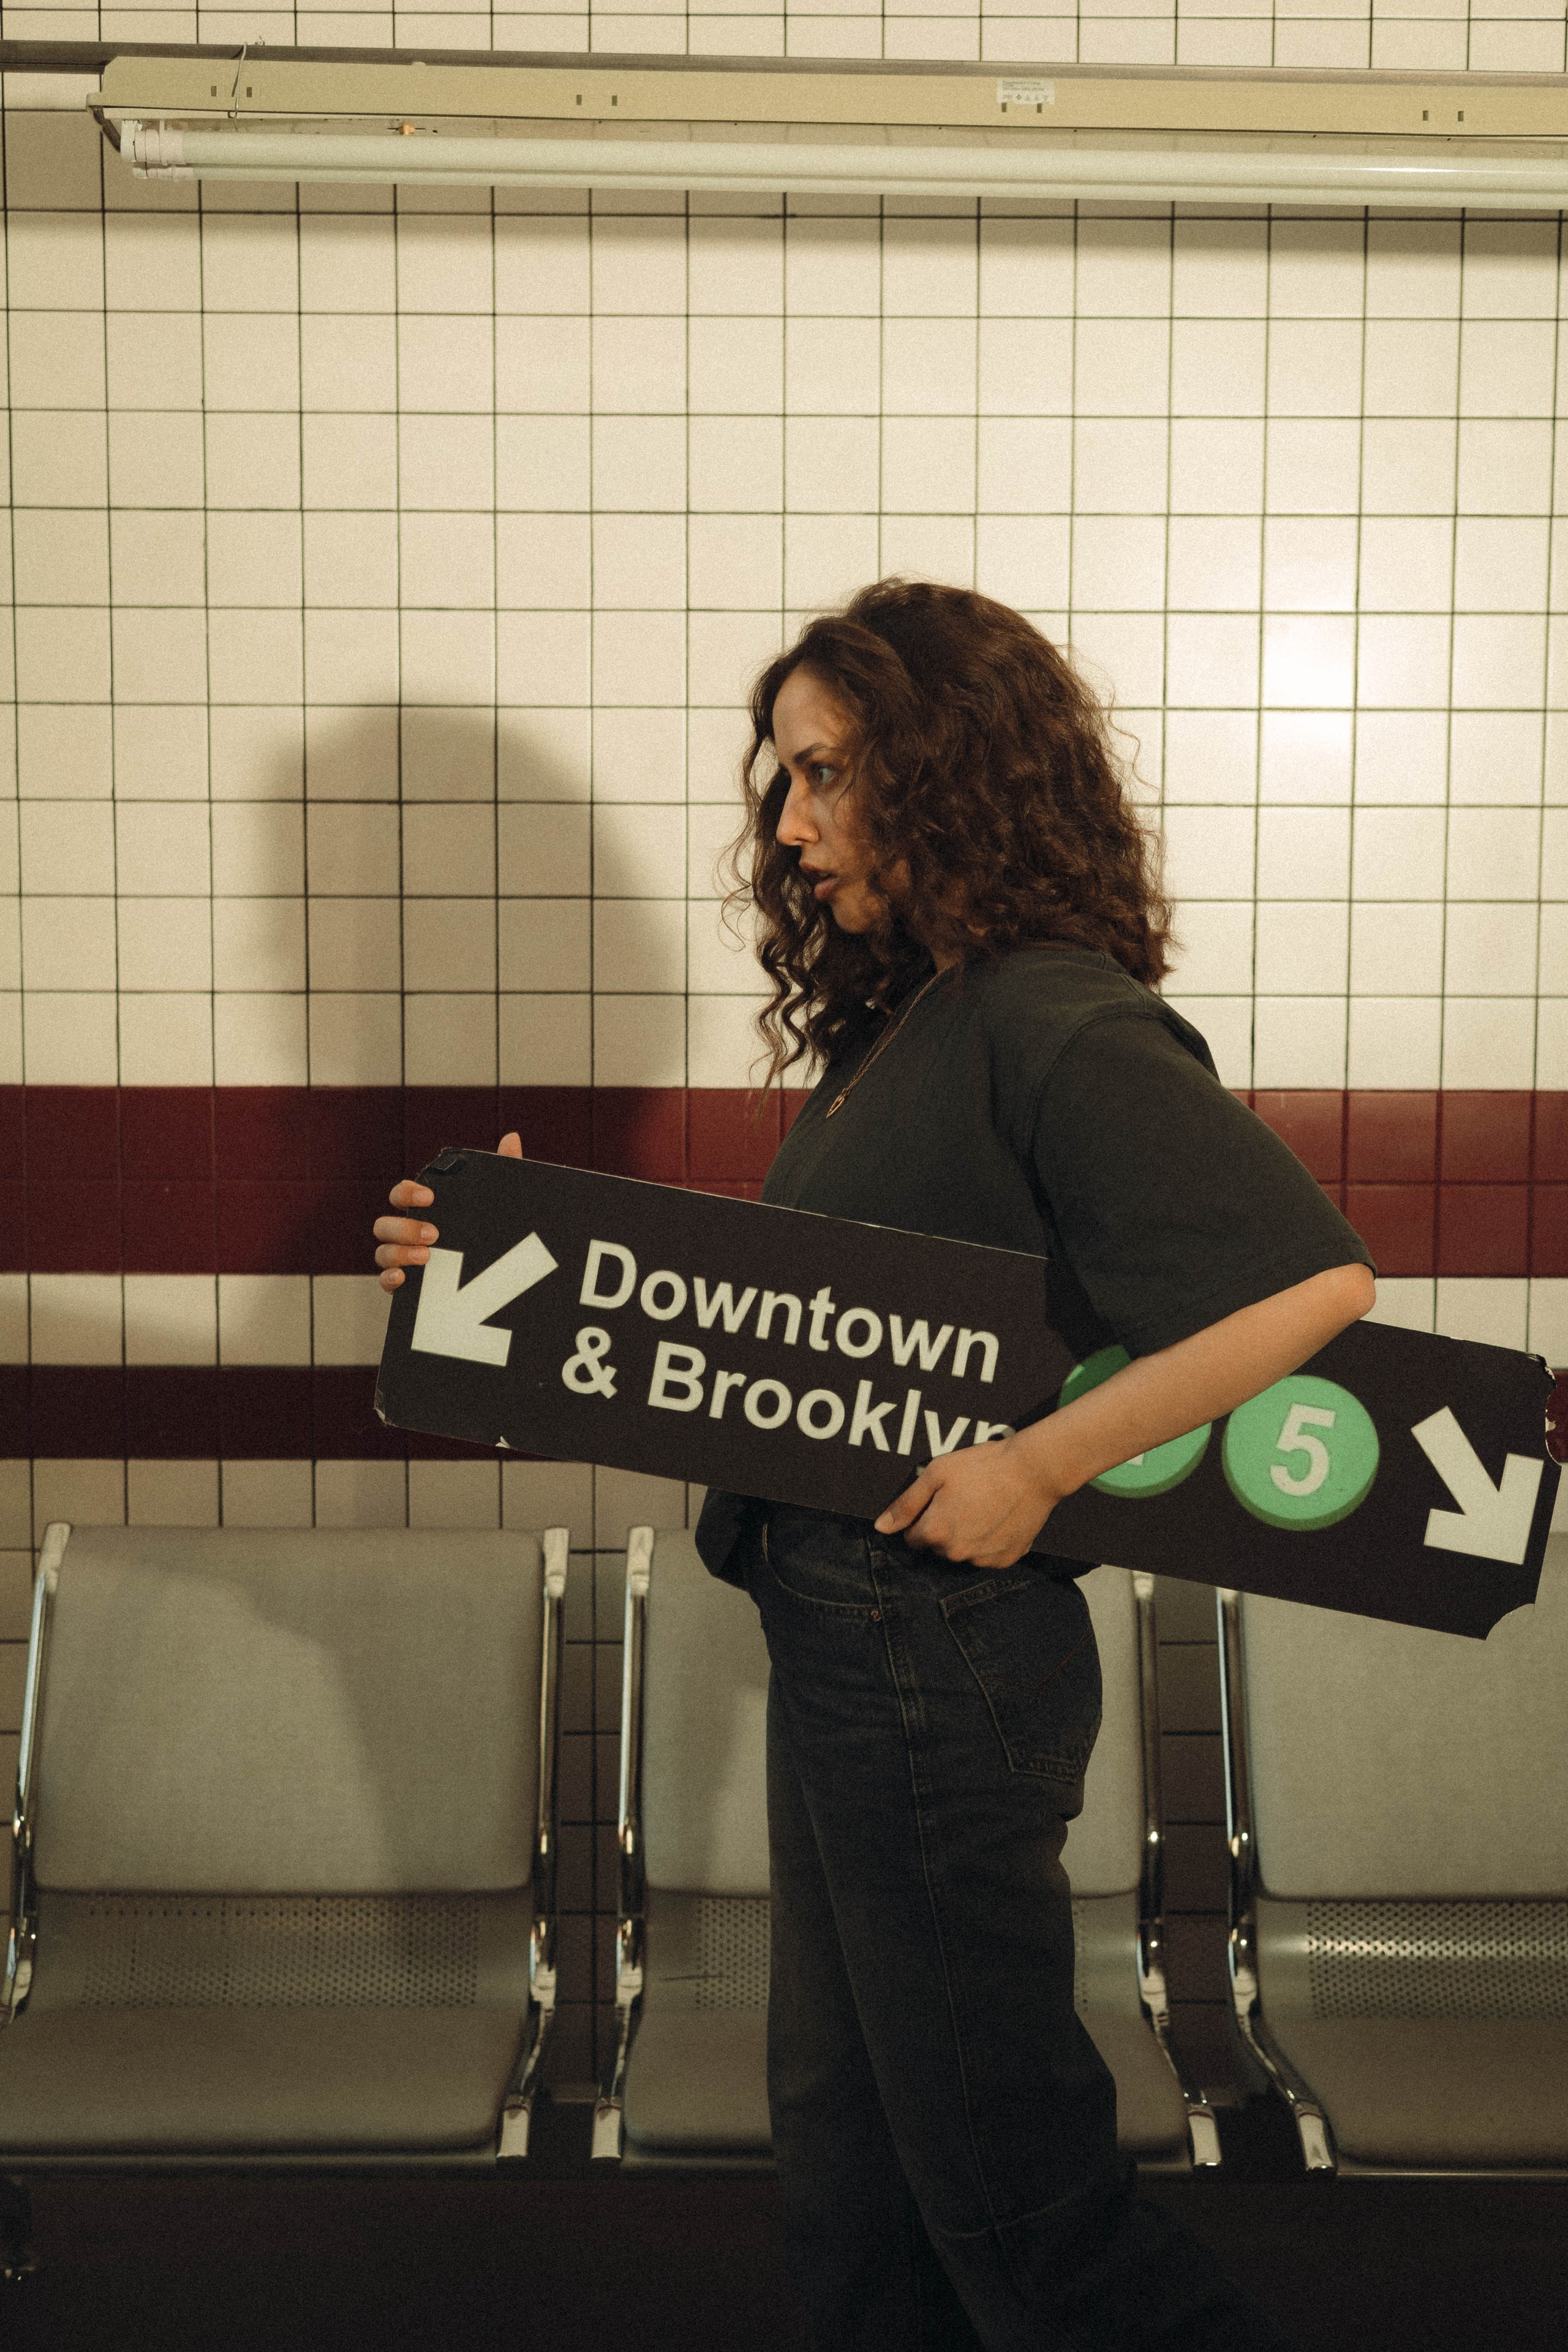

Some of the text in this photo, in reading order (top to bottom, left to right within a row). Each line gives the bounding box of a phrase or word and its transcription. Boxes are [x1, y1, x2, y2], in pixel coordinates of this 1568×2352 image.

[579, 1239, 1000, 1383] Downtown
[562, 1327, 617, 1399] &
[1269, 1403, 1336, 1496] 5
